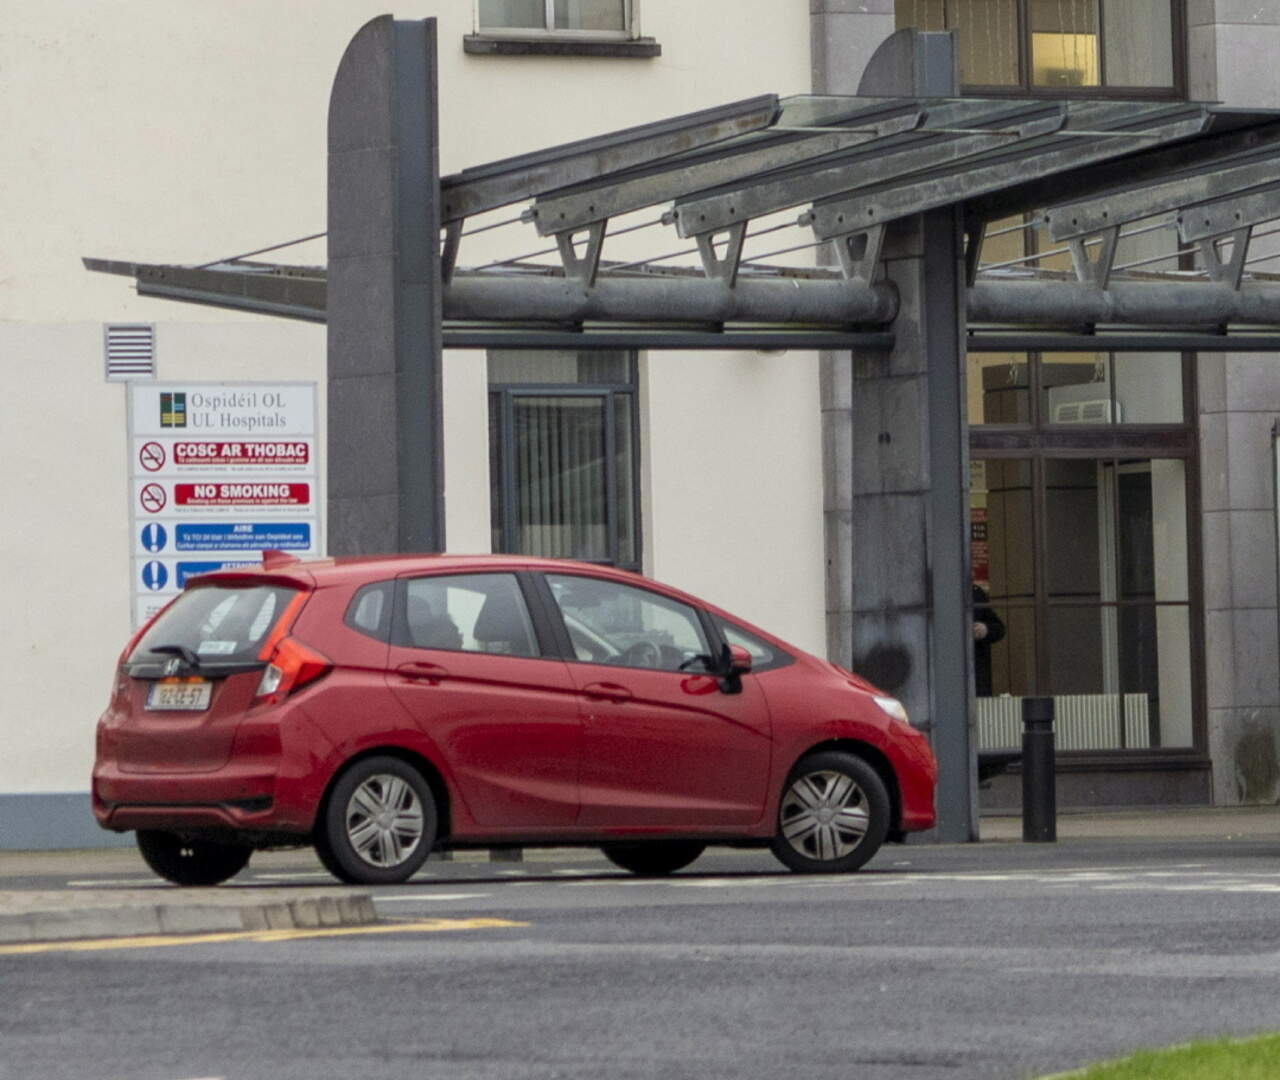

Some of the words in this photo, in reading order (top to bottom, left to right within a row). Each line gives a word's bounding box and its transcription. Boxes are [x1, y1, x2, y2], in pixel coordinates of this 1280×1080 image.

[191, 392, 257, 412] Ospidéil
[262, 392, 287, 408] OL
[192, 412, 215, 428] UL
[220, 412, 287, 432] Hospitals
[176, 443, 218, 457] COSC
[221, 444, 242, 456] AR
[244, 443, 306, 457] THOBAC
[194, 484, 217, 498] NO
[220, 484, 290, 498] SMOKING
